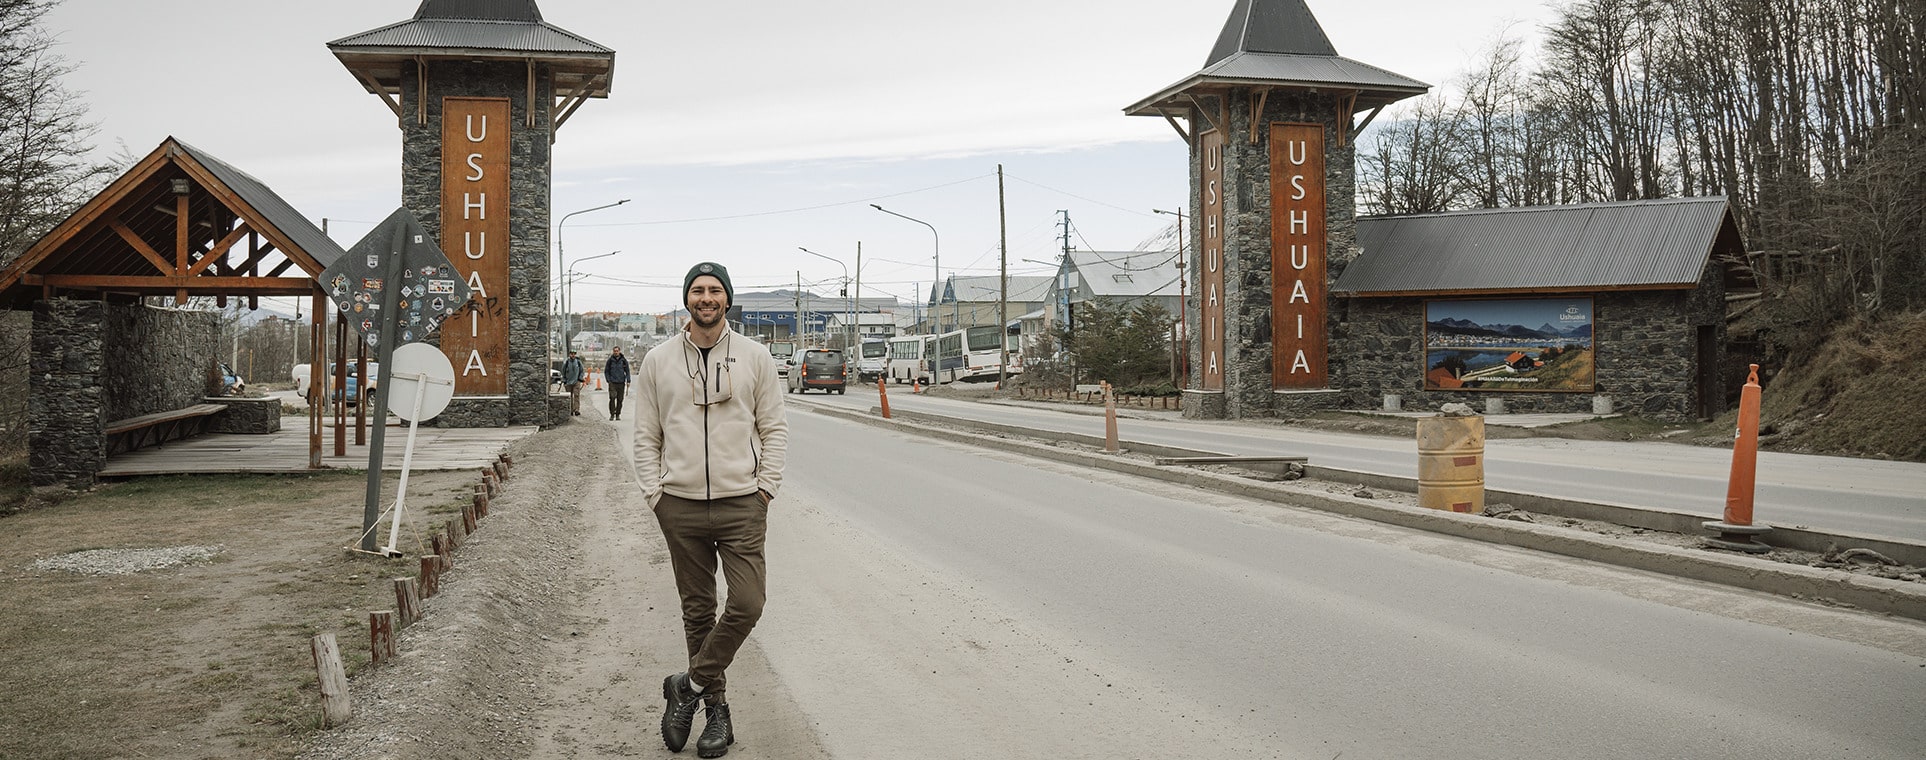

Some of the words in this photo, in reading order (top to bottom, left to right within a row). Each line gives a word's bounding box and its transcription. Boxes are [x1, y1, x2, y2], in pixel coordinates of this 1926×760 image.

[463, 114, 487, 377] USHUAIA
[1208, 146, 1218, 375] USHUAIA
[1289, 139, 1311, 374] USHUAIA
